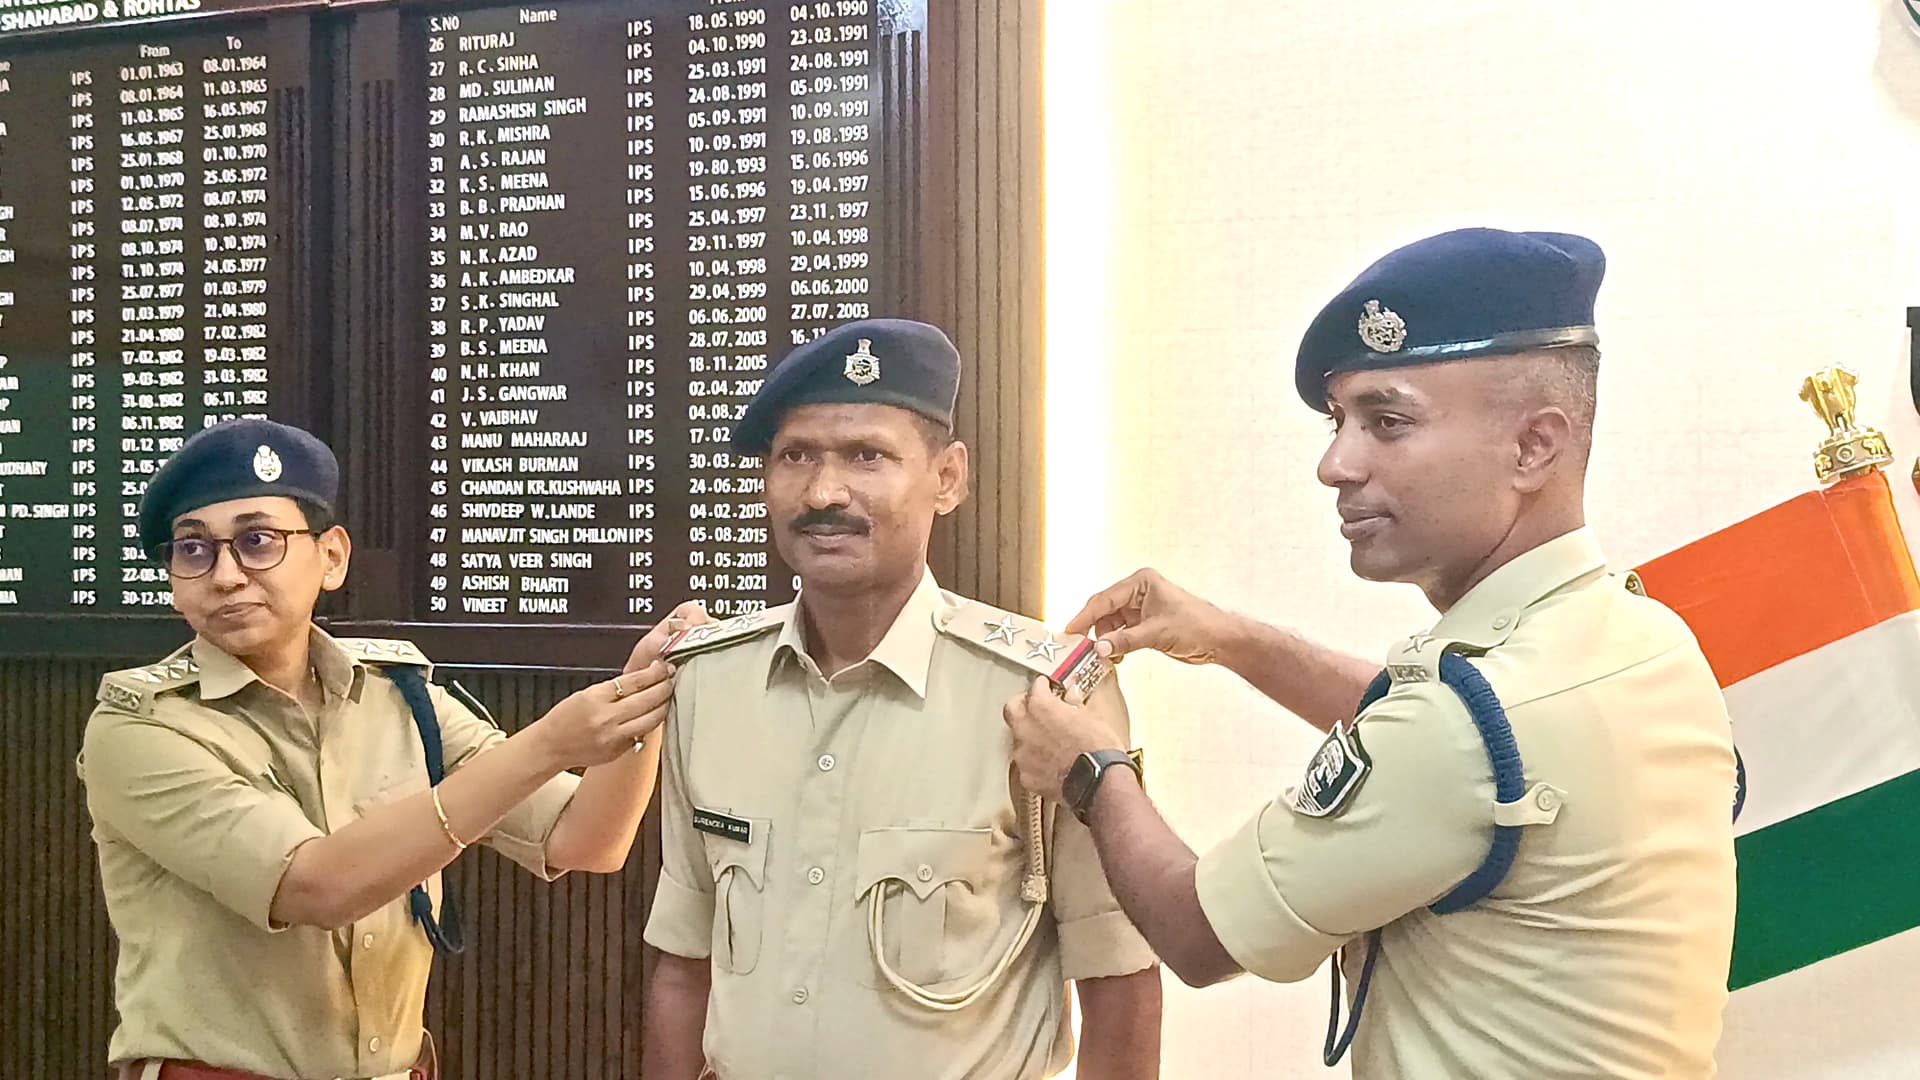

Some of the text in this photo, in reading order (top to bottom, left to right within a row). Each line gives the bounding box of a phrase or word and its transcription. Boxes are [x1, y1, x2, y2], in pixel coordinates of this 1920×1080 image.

[1, 5, 99, 31] SHAHABAD
[103, 1, 119, 18] &
[428, 0, 868, 53] 26 RITURAJ IPS 18.05.1990 04.10.1990
[519, 8, 558, 24] Name
[140, 36, 242, 58] From To
[429, 24, 868, 77] 27 IPS 04.10.1990 23.03.1991
[71, 70, 93, 86] IPS
[203, 55, 267, 74] 08.01.1964
[428, 86, 446, 102] 28
[627, 66, 653, 85] IPS
[687, 57, 766, 80] 25.03.1991
[790, 49, 869, 72] 24.08.1991
[71, 92, 93, 108] IPS
[203, 78, 268, 97] 11.03.1965
[429, 75, 869, 126] 29 RAMASHISH SINGH IPS 24.08.1991 05.09.1991
[203, 100, 268, 119] 16.05.1967
[203, 121, 267, 140] 25.01.1968
[428, 99, 870, 149] 30 IPS 05.09.1991 10.09.1991
[71, 156, 94, 172] IPS
[202, 143, 268, 162] 01.10.1970
[429, 156, 444, 173] 31
[627, 138, 654, 156] IPS
[688, 132, 767, 153] 10.09.1991
[790, 124, 869, 146] 19.08.1993
[203, 166, 268, 185] 25.05.1972
[428, 178, 445, 194] 32
[628, 164, 654, 181] IPS
[688, 156, 767, 177] 19.80.1993
[790, 148, 869, 170] 15.06.1996
[429, 174, 869, 218] 33 IPS 15.06.1996 19.04.1997
[71, 221, 95, 237] IPS
[429, 200, 869, 242] 34 IPS 25.04.1997 23.11.1997
[429, 226, 869, 266] 35 IPS 29.11.1997 10.04.1998
[429, 252, 869, 289] 36 IPS 10.04.1998 29.04.1999
[430, 277, 869, 312] 37 IPS 29.04.1999 06.06.2000
[71, 308, 95, 325] IPS
[430, 302, 870, 336] 38 IPS 06.06.2000 27.07.2003
[430, 329, 767, 359] 39 IPS 28.07.2003
[430, 353, 768, 382] 40 IPS 18.11.2005
[71, 373, 95, 388] IPS
[430, 380, 655, 404] 41 IPS
[430, 413, 447, 429] 42
[627, 403, 654, 419] IPS
[430, 428, 654, 451] 43 MANU MAHARAAJ IPS
[72, 459, 96, 475] IPS
[430, 453, 655, 474] 44 VIKASH BURMAN IPS
[430, 480, 447, 496] 45
[460, 479, 524, 496] CHANDAN
[628, 478, 655, 494] IPS
[73, 502, 97, 518] IPS
[430, 503, 448, 518] 46
[461, 502, 525, 519] SHIVDEEP
[629, 503, 655, 519] IPS
[689, 502, 769, 520] 04.02.2015
[429, 526, 768, 544] 47 MANAVJIT SINGH DHILLON IPS 05.08.2015
[429, 550, 768, 569] 48 SATYA VEER SINGH IPS 01.05.2018
[72, 567, 97, 583] IPS
[430, 573, 767, 593] 49 ASHISH BHARTI IPS 04.01.2021
[73, 590, 96, 605] IPS
[430, 596, 653, 614] 50 VINEET KUMAR IPS
